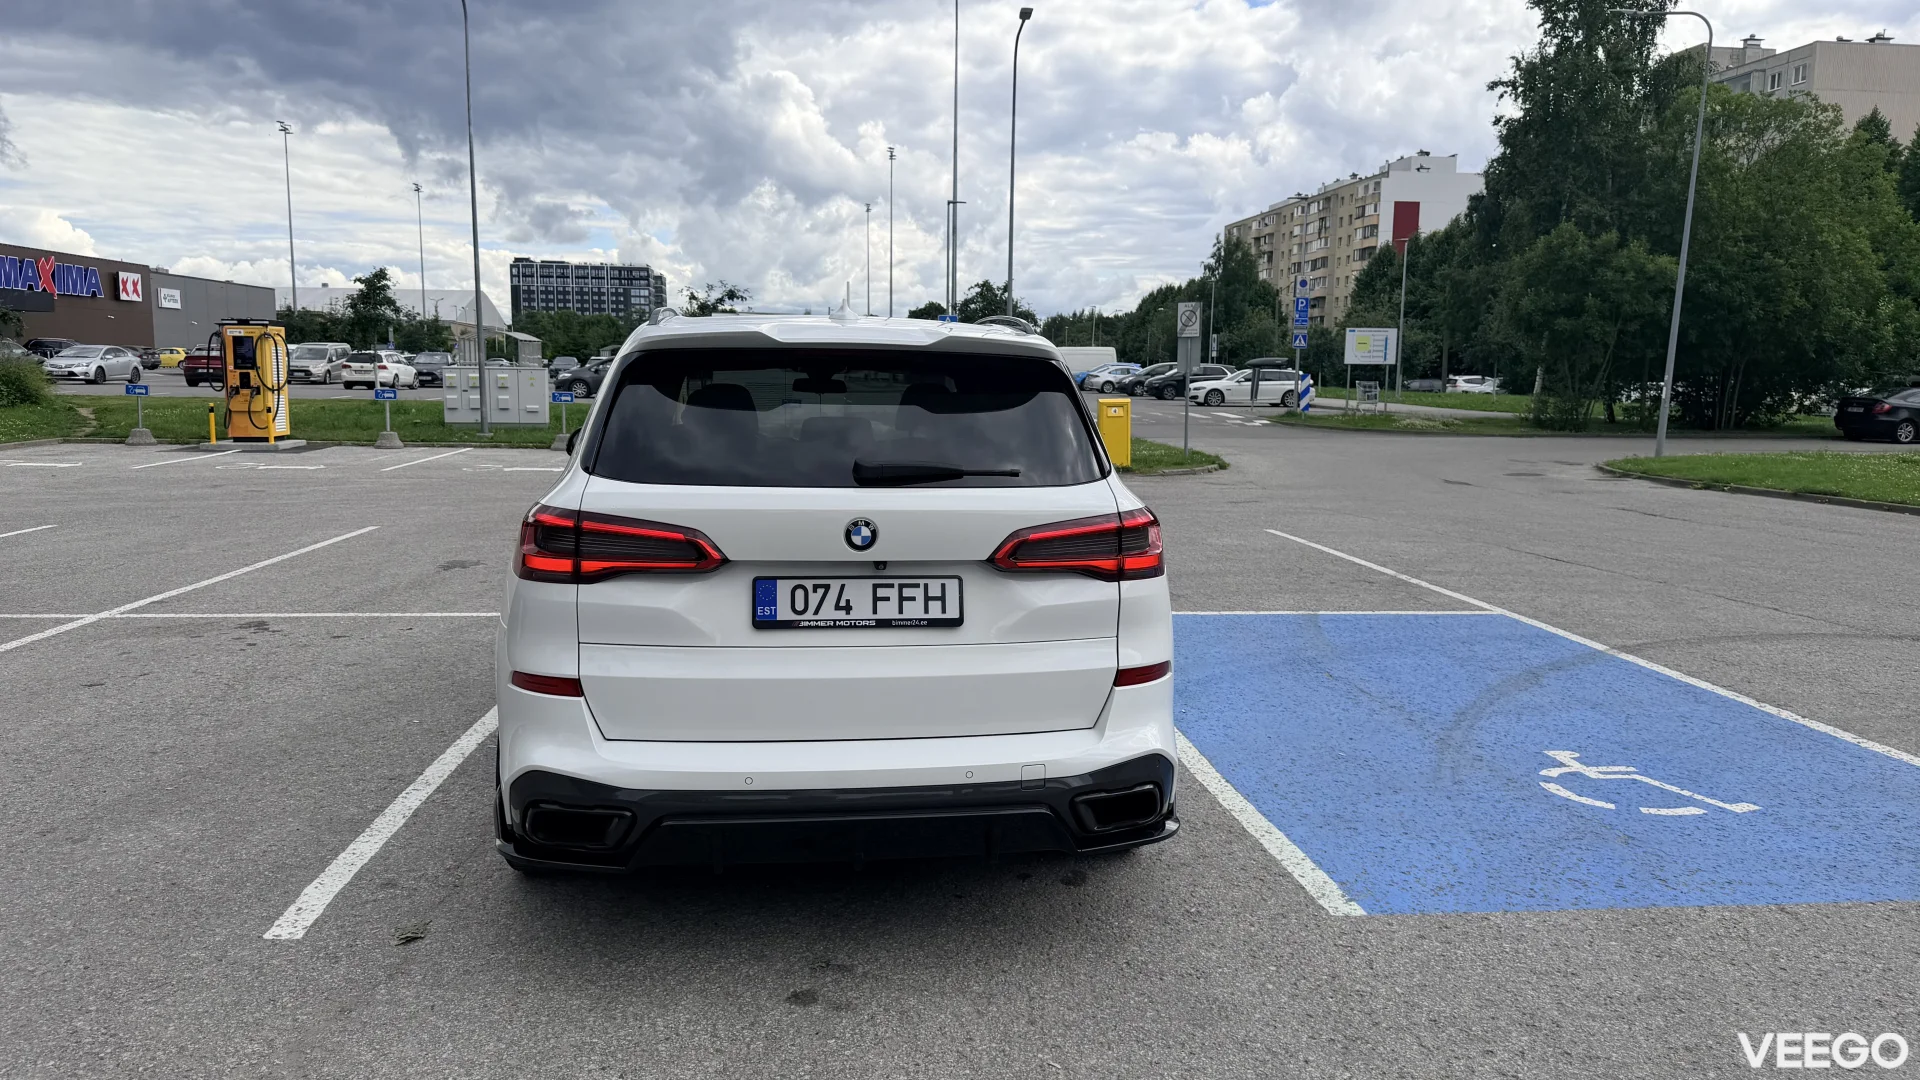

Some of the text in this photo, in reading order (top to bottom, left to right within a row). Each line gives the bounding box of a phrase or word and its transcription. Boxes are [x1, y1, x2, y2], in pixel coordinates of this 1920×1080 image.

[0, 255, 104, 299] MAXIMA
[1298, 299, 1306, 311] P
[790, 583, 947, 616] 074 FFH
[757, 606, 776, 616] EST
